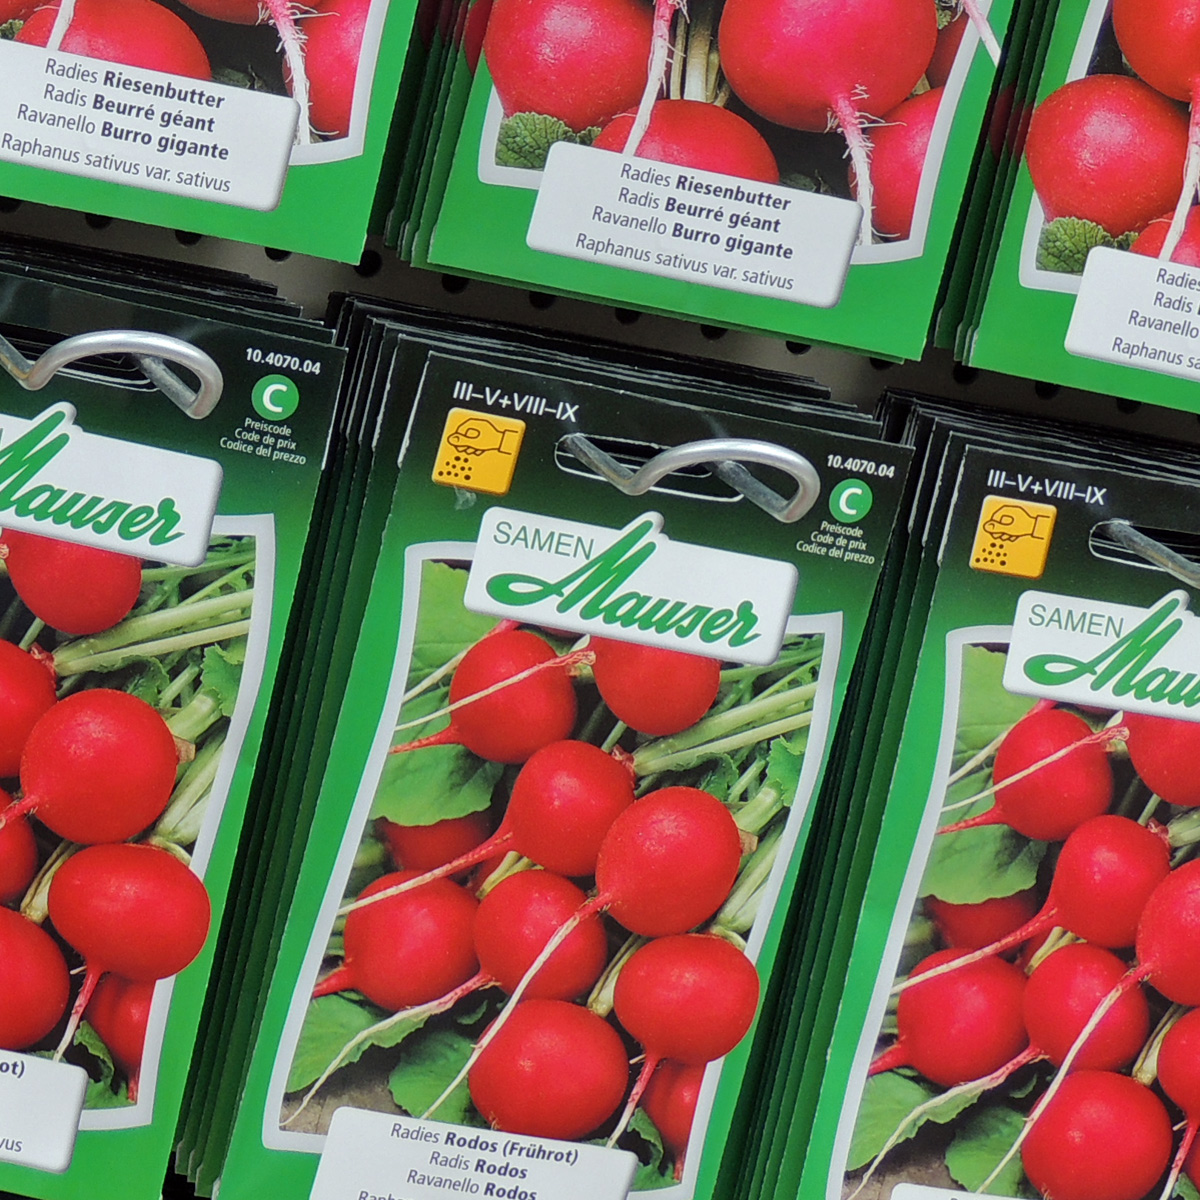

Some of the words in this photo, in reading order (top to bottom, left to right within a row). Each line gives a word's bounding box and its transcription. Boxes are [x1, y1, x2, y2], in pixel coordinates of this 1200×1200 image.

[44, 57, 98, 84] Radies
[102, 69, 225, 109] Riesenbutter
[43, 82, 87, 107] Radis
[91, 93, 155, 121] Beurré
[158, 109, 215, 133] géant
[16, 103, 96, 134] Ravanello
[100, 120, 152, 145] Burro
[155, 133, 229, 160] gigante
[0, 132, 80, 163] Raphanus
[83, 153, 140, 175] sativus
[145, 165, 171, 182] var.
[175, 171, 231, 192] sativus
[620, 162, 671, 187] Radies
[674, 174, 792, 211] Riesenbutter
[1152, 290, 1193, 314] Radis
[1128, 309, 1200, 339] Ravanello
[245, 348, 321, 375] 10.4070.04
[1111, 336, 1184, 365] Raphanus
[262, 383, 288, 414] C
[233, 427, 260, 442] Code
[261, 433, 275, 445] de
[275, 437, 297, 450] prix
[243, 416, 292, 437] Preiscode
[219, 436, 254, 454] Codice
[254, 444, 272, 457] del
[271, 446, 306, 465] prezzo
[827, 454, 895, 479] 10.4070.04
[839, 487, 863, 515] C
[1028, 604, 1124, 638] SAMEN
[390, 1122, 440, 1144] Radies
[443, 1130, 499, 1153] Rodos
[502, 1139, 579, 1166] (Frührot)
